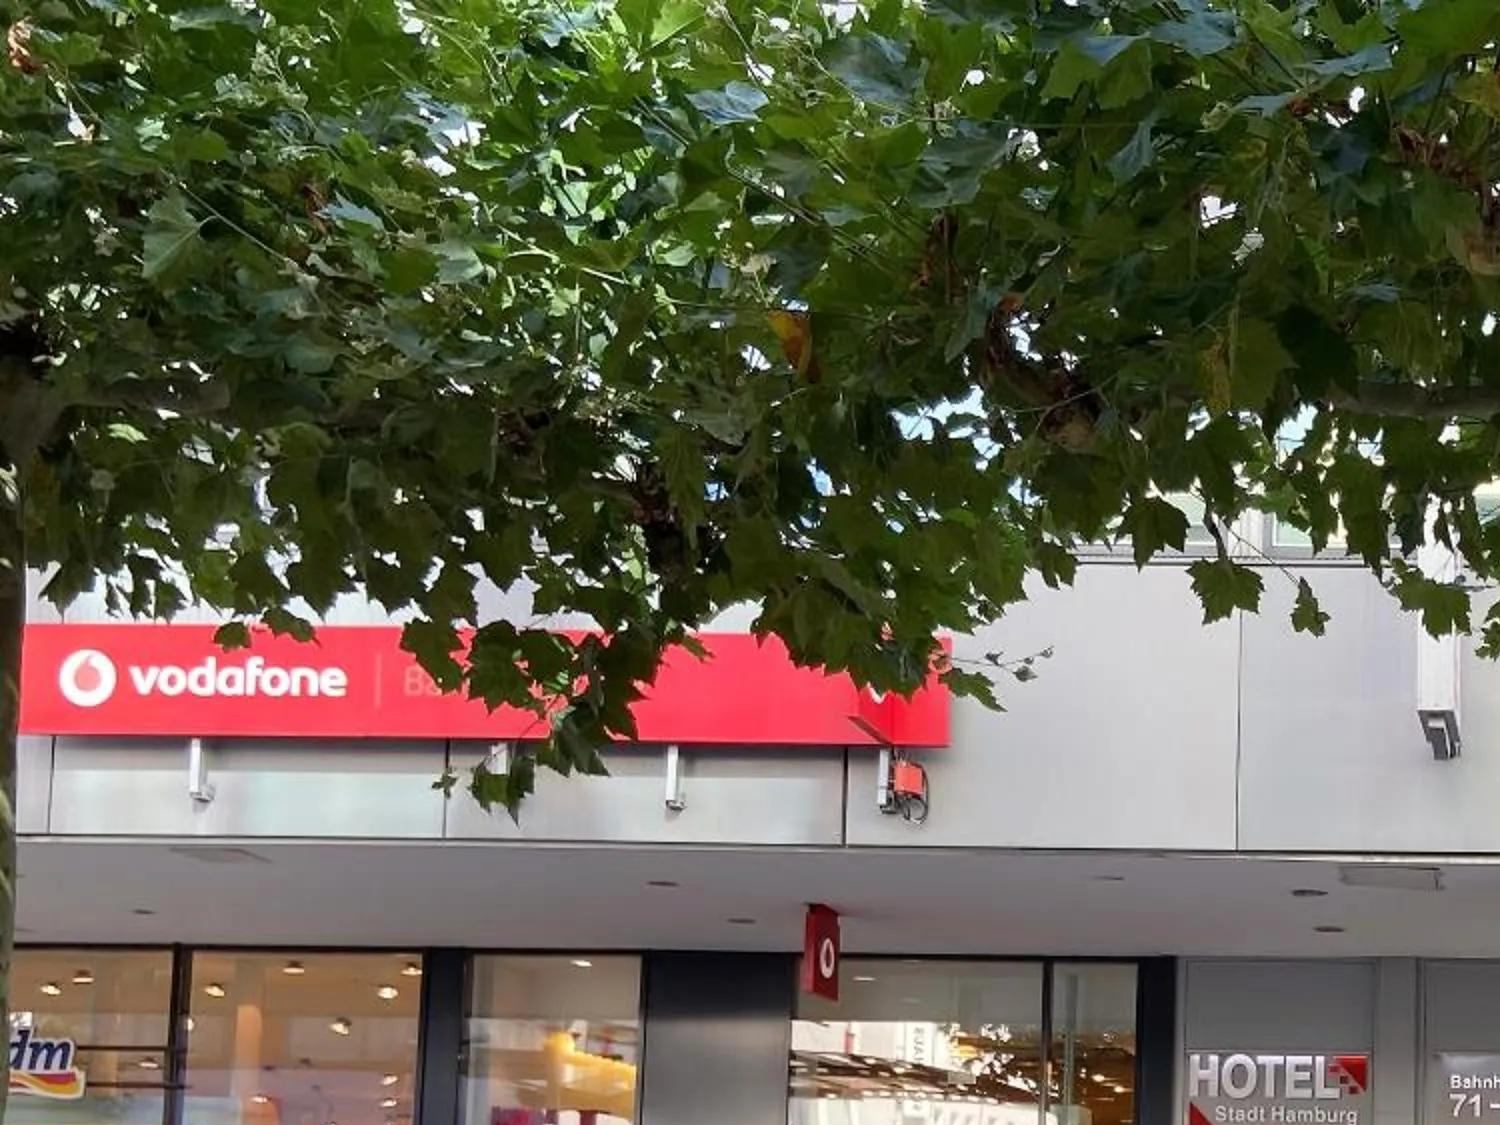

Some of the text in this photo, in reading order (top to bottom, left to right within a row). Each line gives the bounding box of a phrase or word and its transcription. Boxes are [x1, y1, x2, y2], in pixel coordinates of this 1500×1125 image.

[130, 656, 348, 698] vodafone
[9, 1029, 71, 1071] dm
[1188, 1053, 1341, 1099] HOTEL
[1215, 1105, 1265, 1123] Stadt
